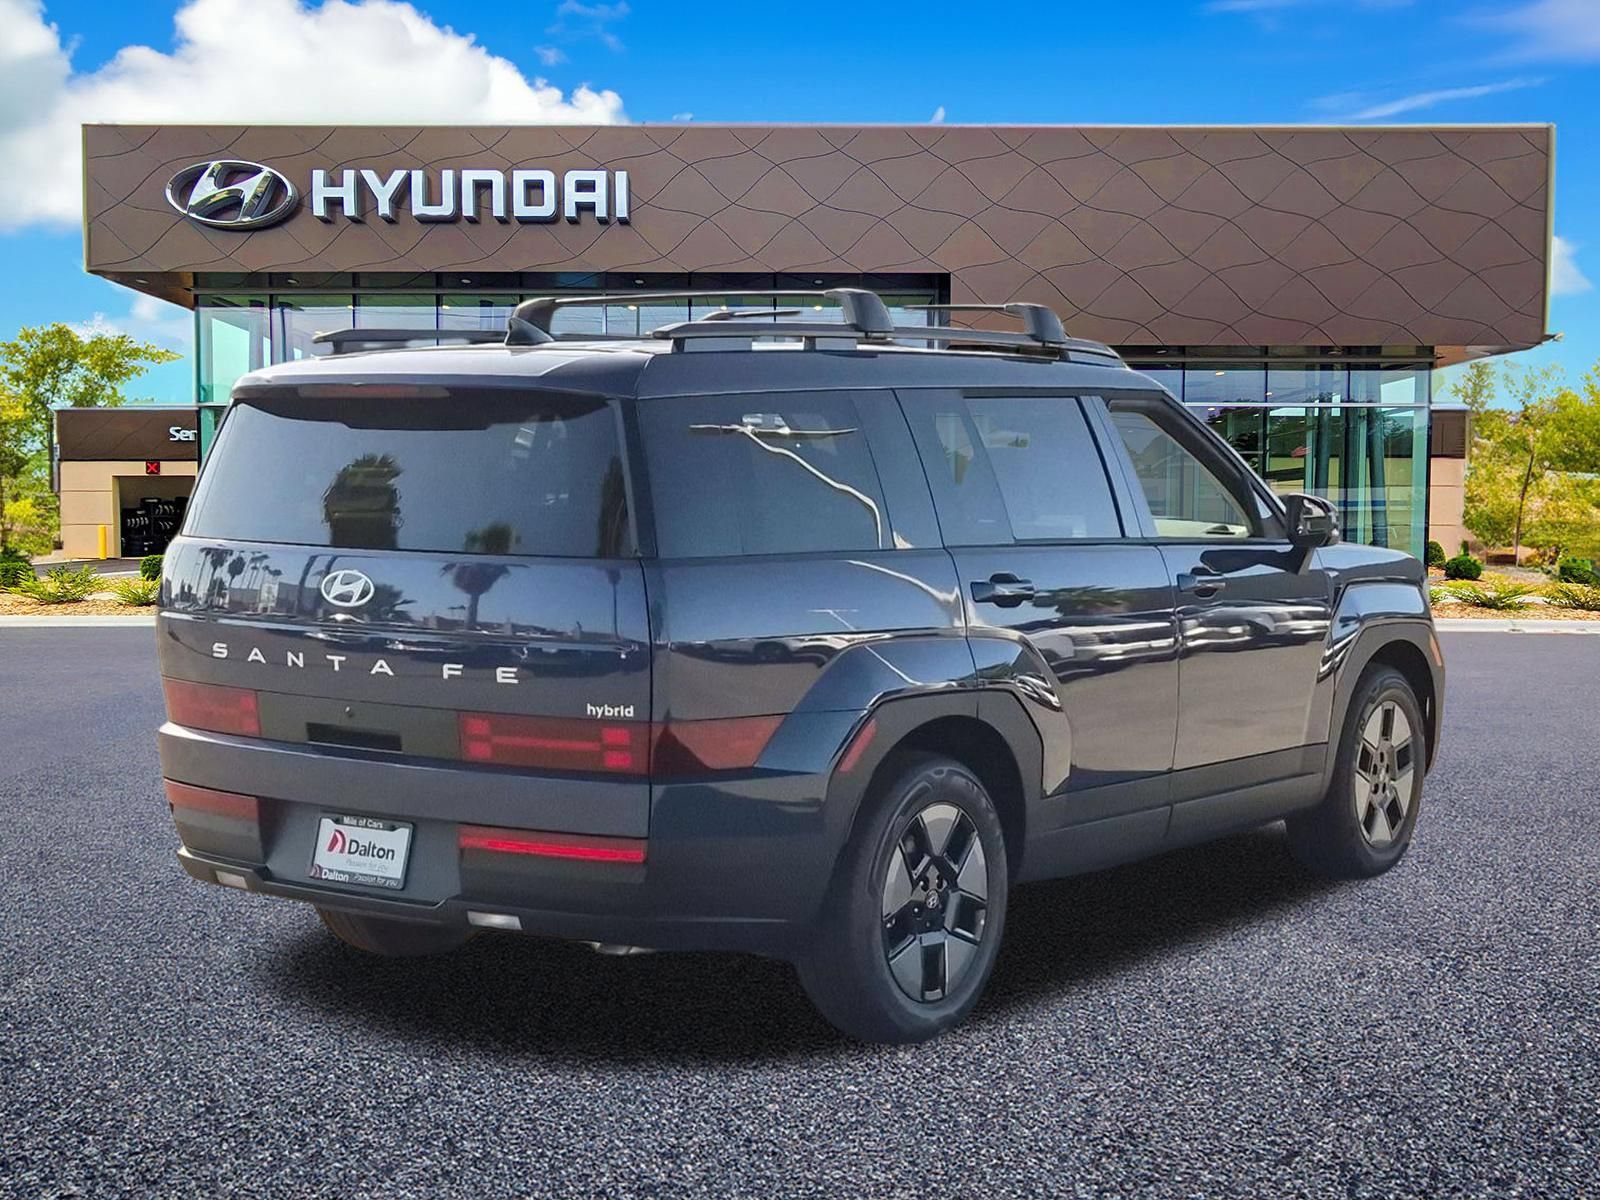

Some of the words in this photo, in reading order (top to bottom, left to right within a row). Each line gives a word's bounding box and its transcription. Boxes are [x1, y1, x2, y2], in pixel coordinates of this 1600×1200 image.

[312, 169, 631, 224] HYUNDAI
[212, 642, 395, 677] SANTA
[442, 663, 520, 684] FE
[586, 703, 635, 719] hybrid
[347, 839, 396, 860] Dalton
[321, 869, 350, 882] Dalton
